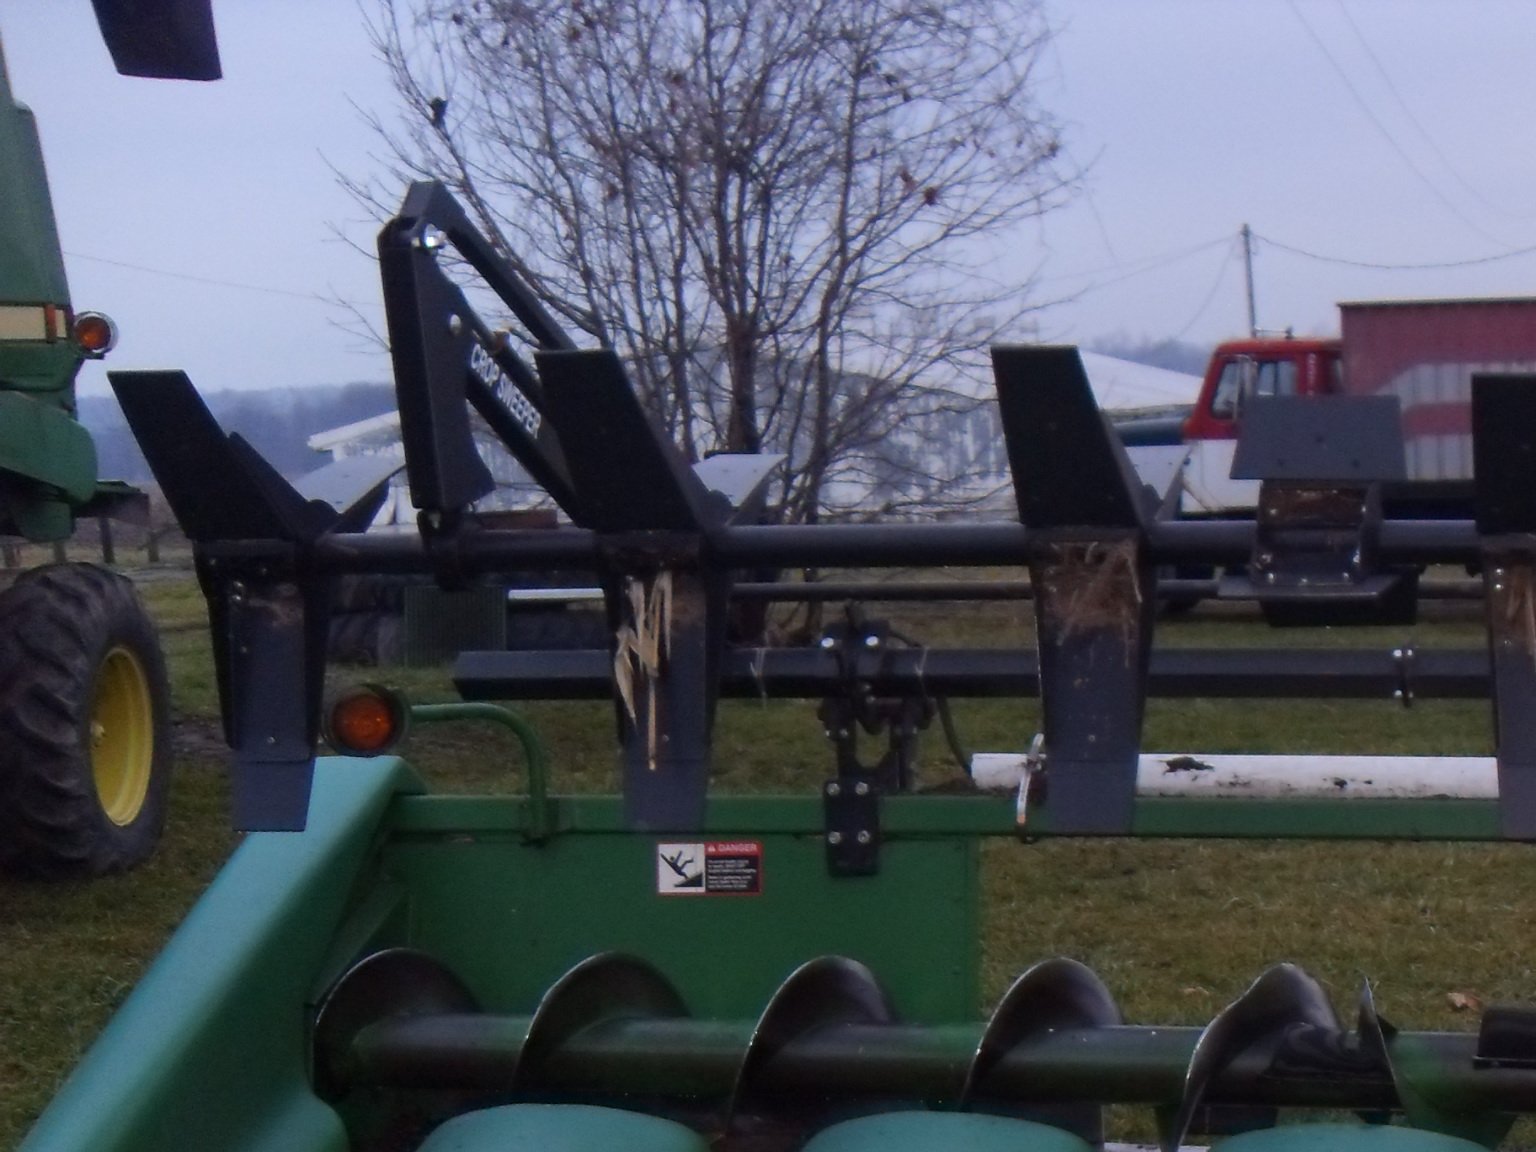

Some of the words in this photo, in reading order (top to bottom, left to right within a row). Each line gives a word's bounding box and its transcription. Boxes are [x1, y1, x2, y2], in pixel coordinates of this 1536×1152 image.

[471, 343, 500, 387] CROP
[497, 373, 541, 439] SWEEPER
[718, 843, 758, 852] DANGER
